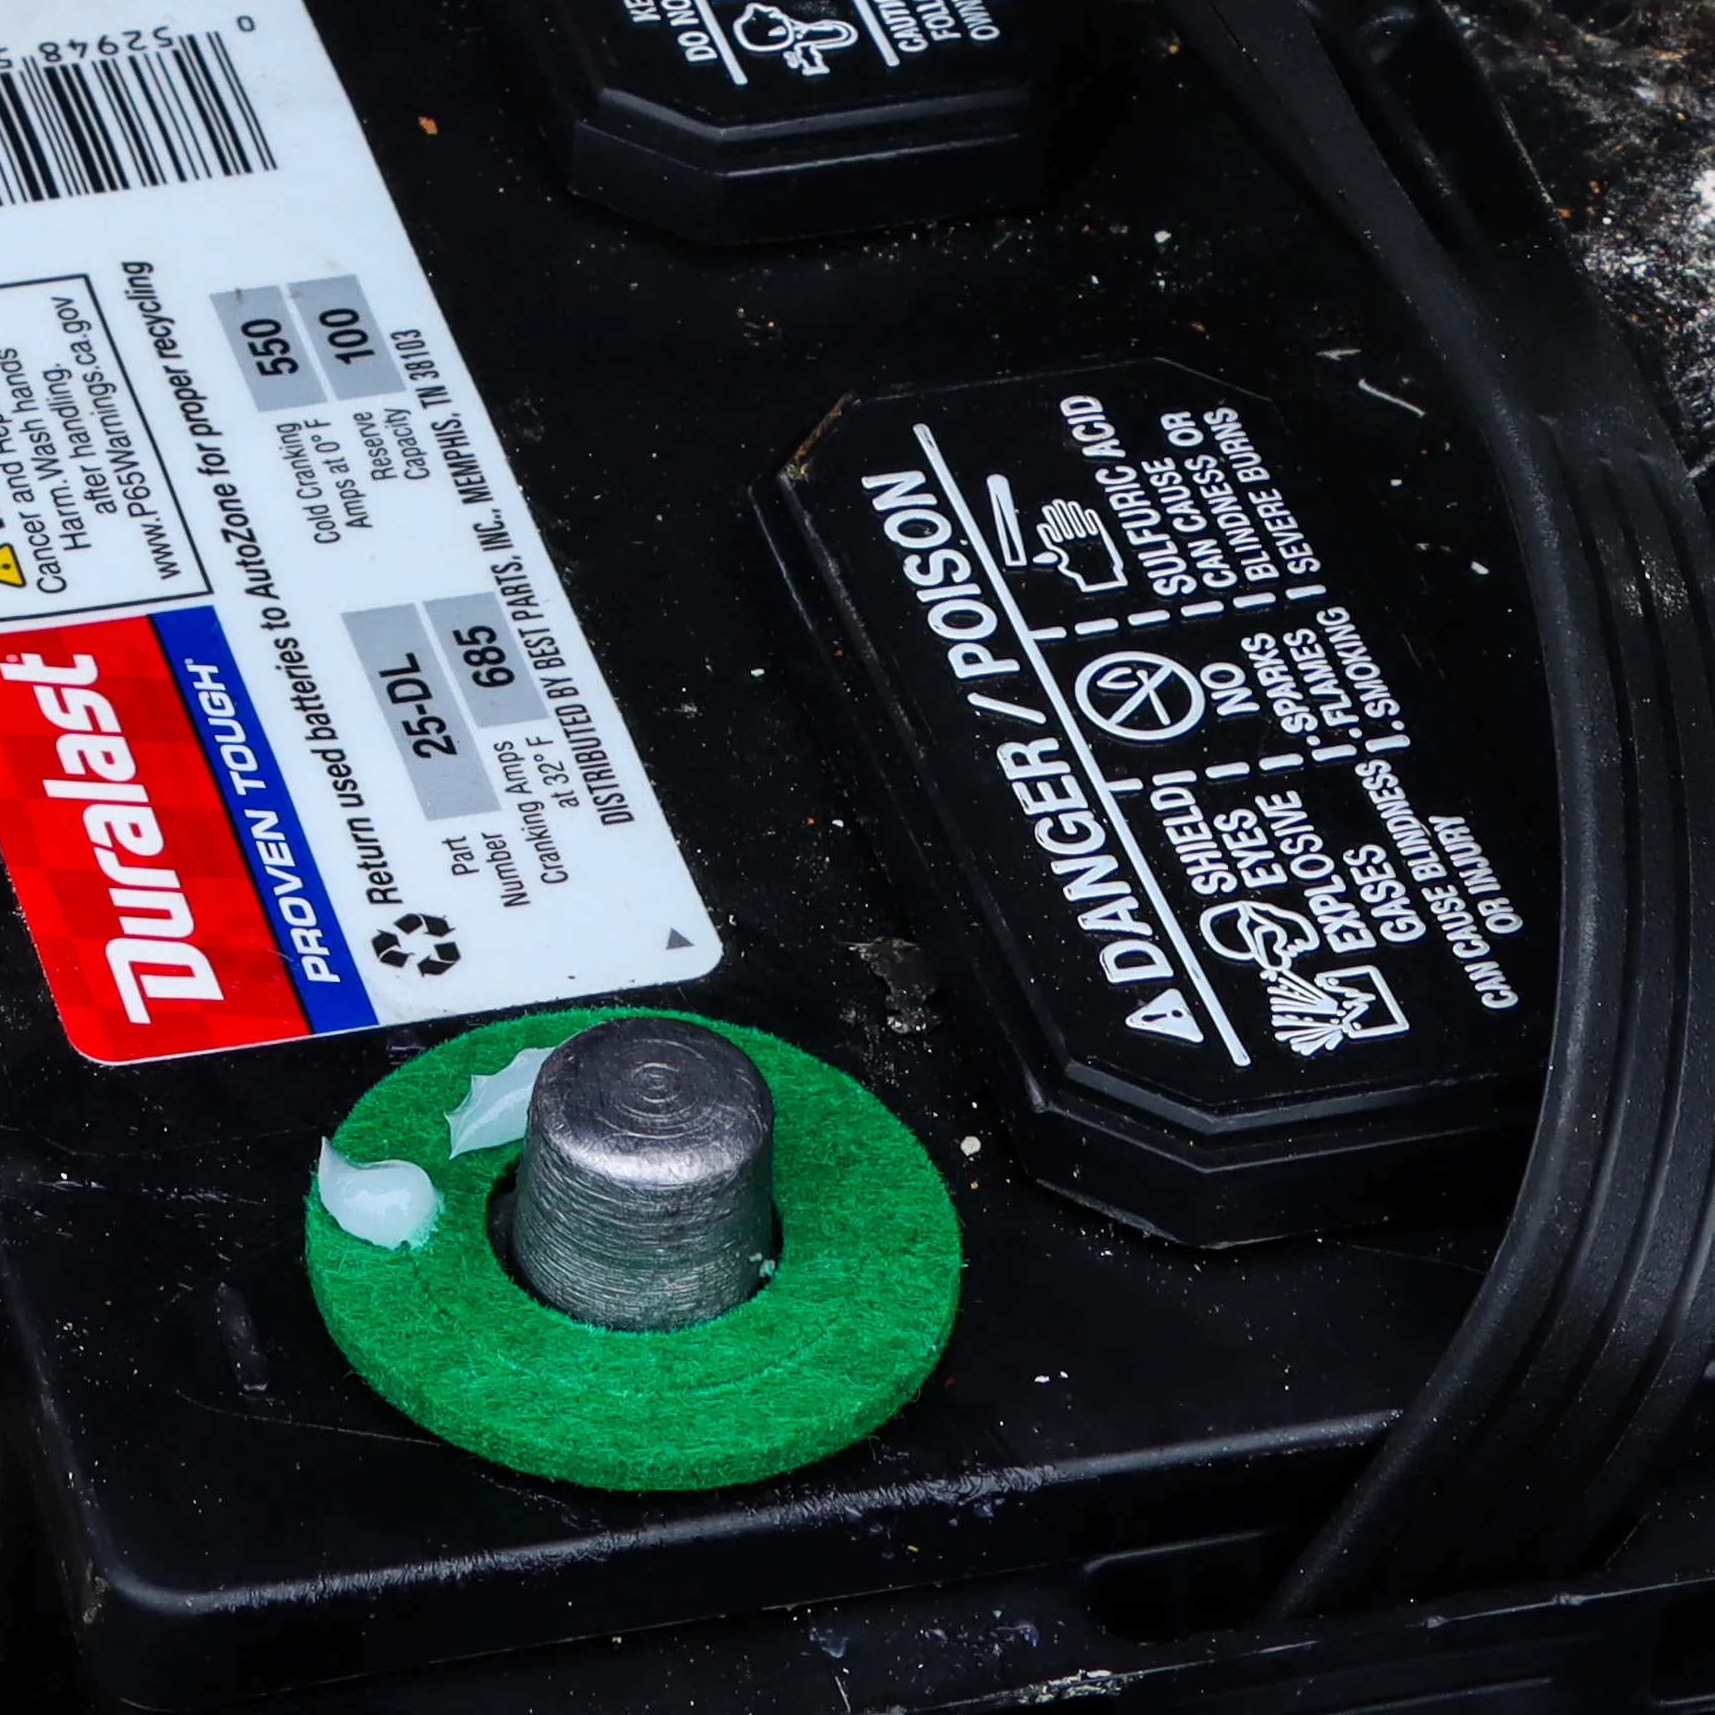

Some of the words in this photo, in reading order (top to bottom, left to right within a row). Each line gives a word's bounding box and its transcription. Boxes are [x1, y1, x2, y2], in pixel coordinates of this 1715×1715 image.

[38, 25, 174, 63] 52948
[236, 15, 256, 33] 0
[677, 31, 718, 62] DO
[121, 261, 182, 359] recycling
[240, 318, 299, 376] 550
[318, 308, 375, 365] 100
[389, 329, 440, 381] 38103
[42, 363, 96, 459] handling.
[162, 365, 223, 437] proper
[415, 385, 452, 410] TN
[1059, 395, 1126, 458] ACID
[1160, 411, 1204, 447] OR
[51, 296, 181, 580] www.P65Warnings.ca.gov
[195, 442, 231, 476] for
[275, 422, 323, 500] Cranking
[352, 411, 407, 481] Reserve
[383, 408, 431, 480] Capacity
[430, 413, 494, 505] MEMPHIS,
[1203, 407, 1271, 483] BURNS
[79, 465, 118, 514] after
[302, 504, 341, 544] Cold
[1140, 457, 1207, 533] CAUSE
[1184, 454, 1280, 582] BLINDNESS
[18, 511, 68, 594] Cancer
[213, 483, 280, 600] AutoZone
[472, 508, 514, 552] INC.,
[1094, 465, 1197, 596] SULFURIC
[1187, 538, 1238, 588] CAN
[1247, 488, 1321, 575] SEVERE
[490, 555, 544, 621] PARTS,
[861, 470, 1021, 679] POISON
[260, 606, 291, 631] to
[452, 625, 515, 688] 685
[517, 627, 566, 670] BEST
[273, 637, 339, 741] batteries
[539, 677, 580, 699] BY
[1200, 662, 1260, 716] NO
[1240, 632, 1319, 734] SPARKS
[1282, 628, 1360, 727] FLAMES
[1316, 606, 1401, 718] SMOKING
[184, 659, 266, 796] TOUGH
[378, 652, 458, 759] 25-DL
[310, 748, 365, 808] used
[493, 741, 533, 794] Amps
[554, 703, 635, 826] DISTRIBUTED
[441, 835, 480, 876] Part
[517, 800, 569, 884] Cranking
[1149, 786, 1238, 895] SHIELD
[1213, 808, 1288, 889] EYES
[1354, 759, 1448, 882] BLINDNESS
[1428, 816, 1502, 895] INJURY
[244, 809, 341, 983] PROVEN
[346, 817, 403, 905] Return
[481, 832, 531, 908] Number
[996, 737, 1174, 984] DANGER
[1254, 790, 1377, 954] EXPLOSIVE
[1342, 844, 1427, 942] GASES
[1421, 884, 1491, 959] CAUSE
[1477, 897, 1523, 934] OR
[1463, 961, 1519, 1009] CAN
